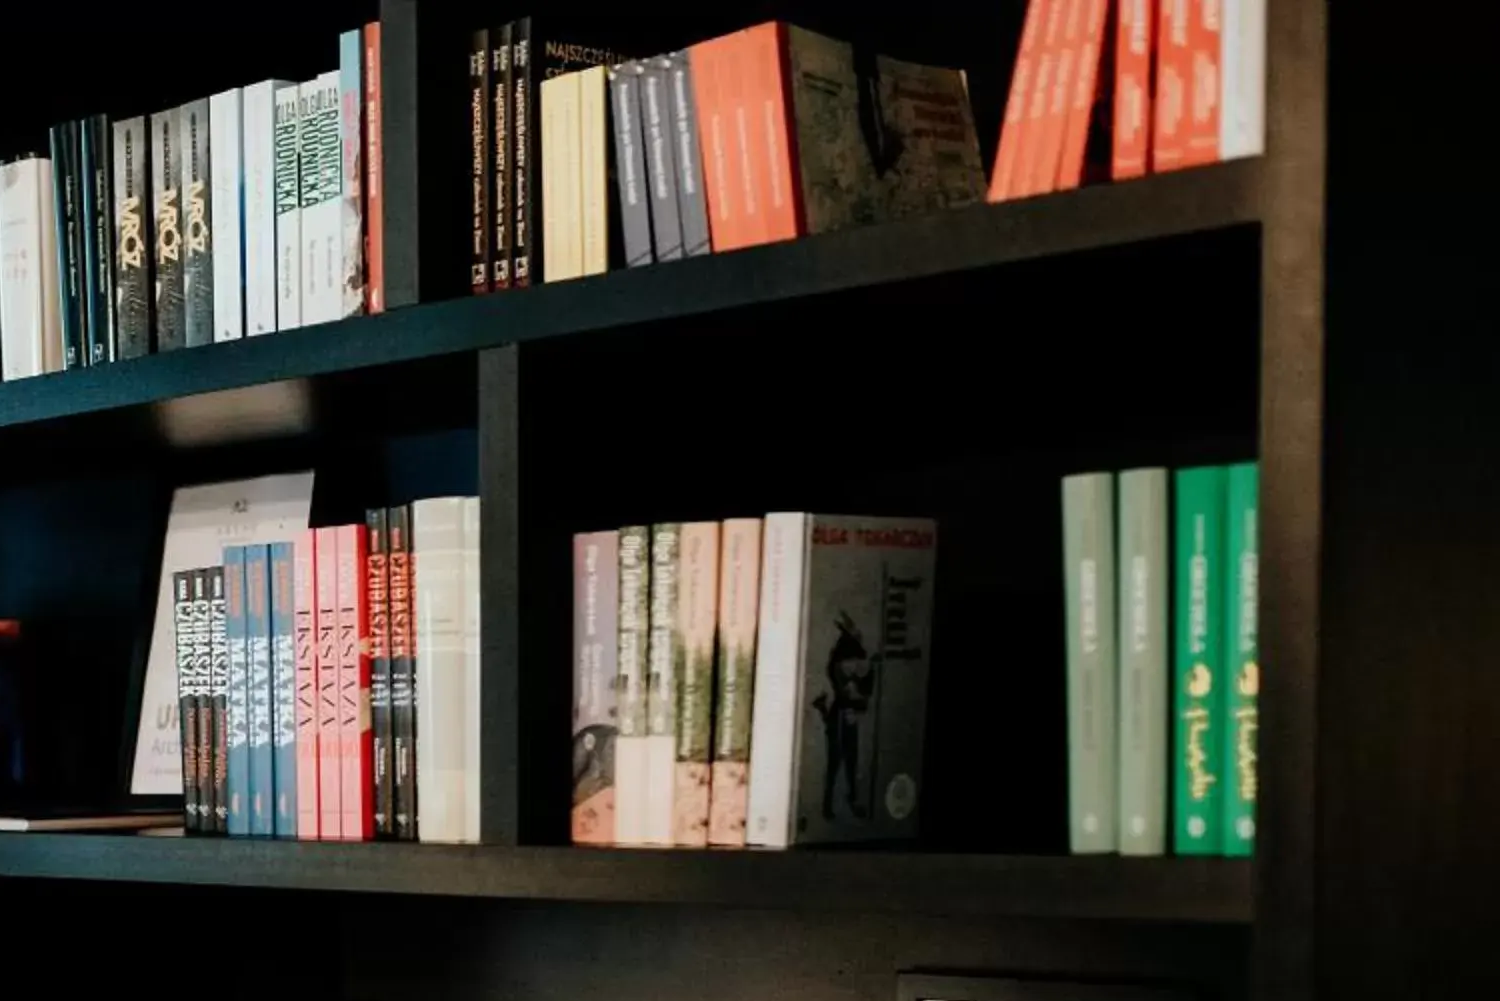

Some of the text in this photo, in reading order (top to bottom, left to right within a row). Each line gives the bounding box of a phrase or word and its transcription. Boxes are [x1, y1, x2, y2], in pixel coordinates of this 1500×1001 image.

[276, 123, 297, 216] RUDNICKA
[300, 116, 319, 209] RUDNICKA
[319, 109, 339, 203] RUDNICKA
[120, 196, 145, 271] MRÓZ
[158, 189, 182, 264] MRÓZ
[186, 178, 209, 257] MRÓZ
[176, 601, 195, 698] CZUBASZEK
[193, 599, 211, 698] CZUBASZEK
[211, 599, 227, 697] CZUBASZEK
[368, 553, 388, 660] CZUBASZEK
[390, 551, 410, 659] CZUBASZEK
[231, 638, 246, 748] MATKA
[253, 636, 269, 746] MATKA
[277, 634, 294, 747] MATKA
